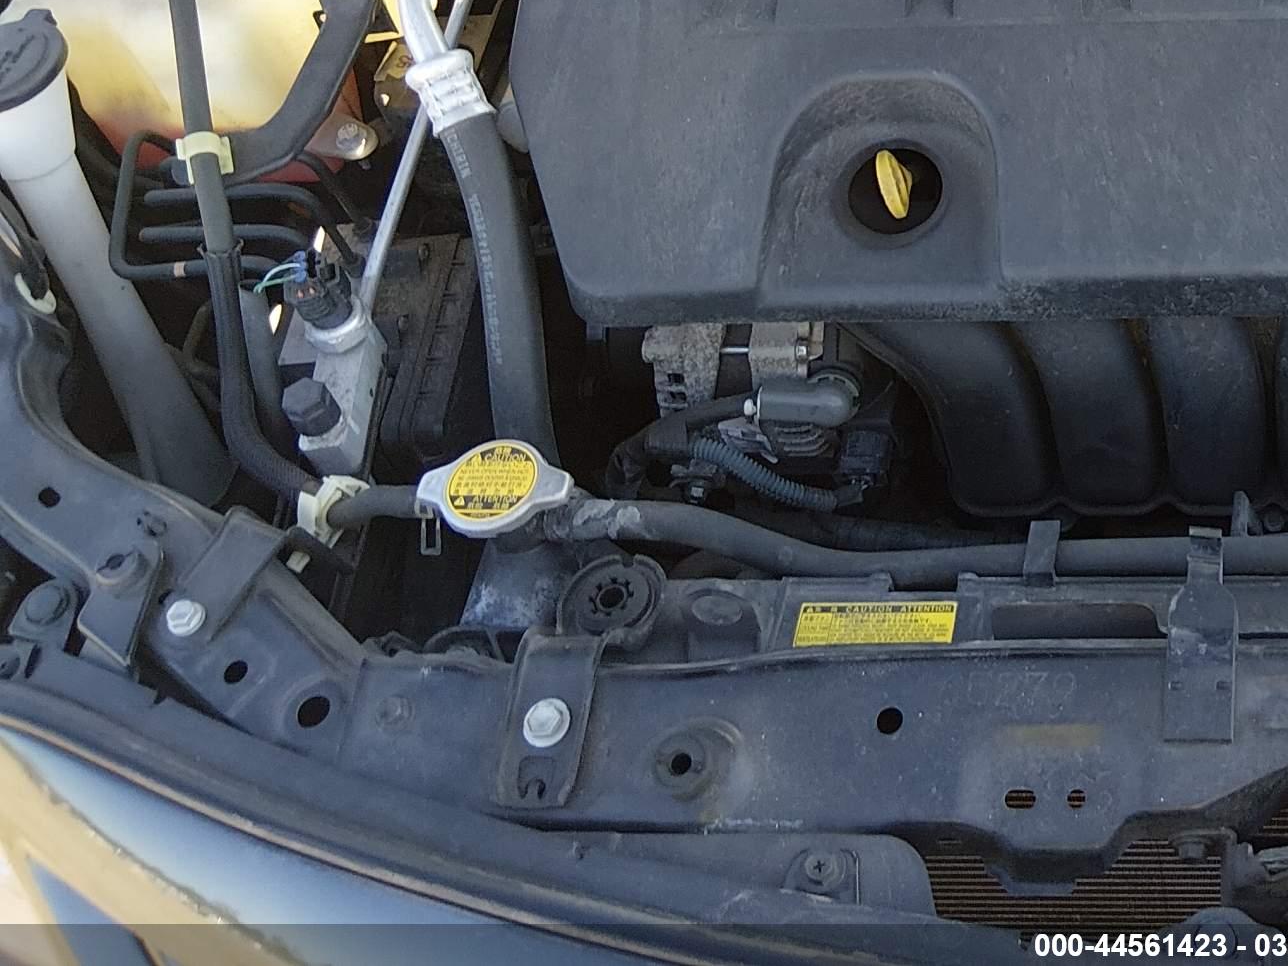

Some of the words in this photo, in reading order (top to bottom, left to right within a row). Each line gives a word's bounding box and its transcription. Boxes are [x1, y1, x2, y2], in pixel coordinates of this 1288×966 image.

[485, 452, 527, 462] CAUTION
[472, 495, 519, 504] ATTENTION
[846, 604, 893, 613] CAUTION
[899, 603, 953, 613] ATTENTION
